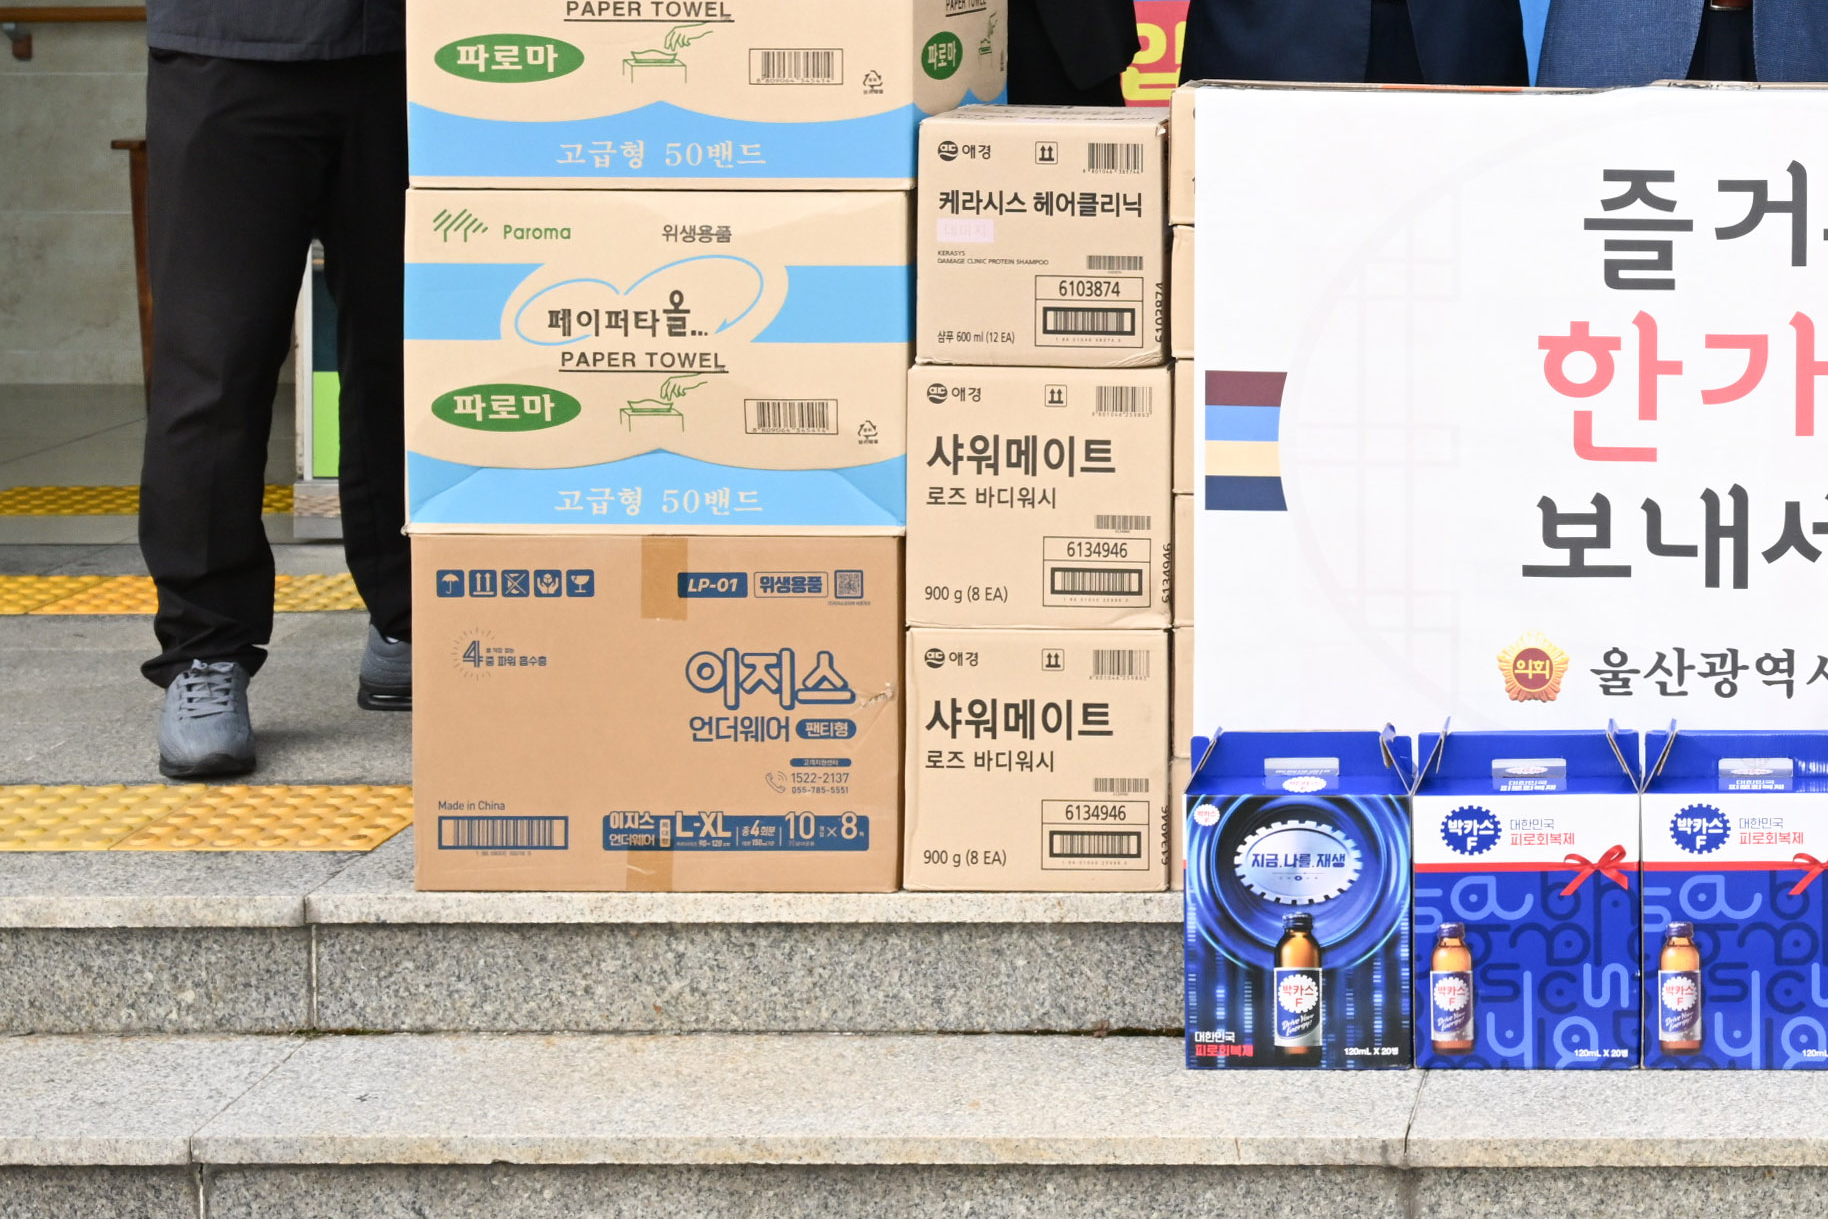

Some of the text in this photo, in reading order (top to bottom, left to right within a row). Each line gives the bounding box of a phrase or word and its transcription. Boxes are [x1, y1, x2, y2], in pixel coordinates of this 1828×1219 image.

[566, 1, 732, 18] PAPER TOWEL
[456, 45, 558, 73] 파로마
[928, 41, 956, 70] 파로마
[556, 140, 766, 168] 고급형 50밴드
[962, 144, 991, 159] 애경
[939, 190, 1142, 217] 케라시스 헤어클리닉
[503, 224, 571, 240] Paroma
[662, 224, 732, 243] 위생용품
[1059, 280, 1120, 297] 6103874
[937, 331, 1015, 344] 샴푸 600 ml (12 EA)
[561, 352, 726, 369] PAPER TOWEL
[951, 387, 981, 402] 애경
[454, 395, 555, 421] 파로마
[927, 434, 1116, 477] 샤워메이트
[555, 489, 763, 516] 고급형 50밴드
[926, 487, 1056, 509] 로즈 바디워시
[1067, 542, 1127, 558] 6134946
[688, 578, 738, 592] LP-01
[759, 576, 823, 594] 위생용품
[925, 586, 1008, 603] 900 g (8 EA)
[949, 651, 979, 666] 애경
[1514, 658, 1551, 680] 의회
[686, 647, 856, 710] 이지스
[925, 698, 1113, 741] 샤워메이트
[689, 716, 849, 742] 언더웨어 팬티형
[925, 750, 1054, 772] 로즈 바디워시
[791, 773, 850, 783] 1522-2137
[792, 786, 849, 794] 055-785-5551
[438, 801, 505, 811] Made in China
[1066, 805, 1126, 821] 6134946
[609, 811, 655, 829] 이지스
[675, 811, 732, 837] L-XL
[1448, 820, 1494, 836] 박카스
[1510, 818, 1555, 830] 대한민국
[1677, 818, 1724, 835] 박카스
[1739, 817, 1784, 829] 대한민국
[609, 834, 655, 846] 언더웨어
[1467, 837, 1477, 850] F
[1510, 832, 1575, 846] 피로회복제
[1739, 831, 1804, 845] 피로회복제
[1283, 986, 1314, 996] 박카스
[1437, 986, 1466, 997] 박카스
[1296, 998, 1302, 1007] F
[1449, 998, 1455, 1006] F
[1195, 1032, 1235, 1042] 대한민국
[1195, 1043, 1253, 1057] 피로회복제
[1382, 1047, 1398, 1055] 20병
[1574, 1049, 1601, 1058] 120mL
[1612, 1049, 1628, 1058] 20병
